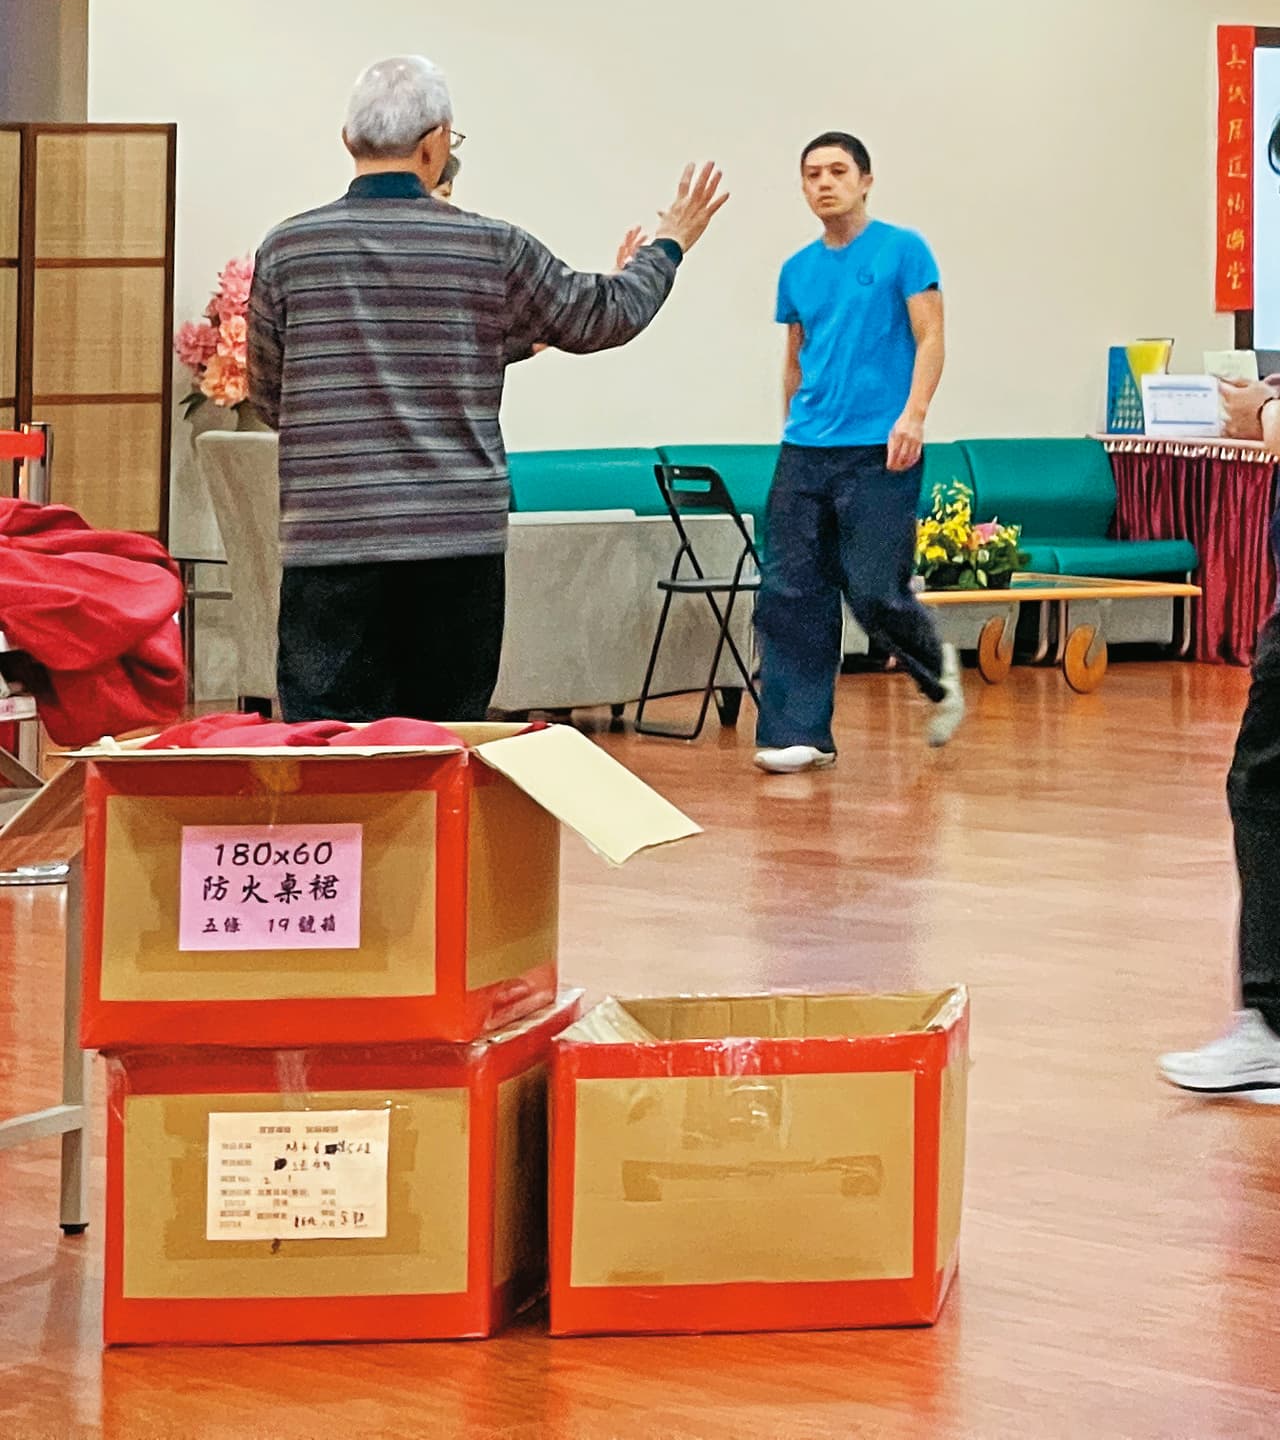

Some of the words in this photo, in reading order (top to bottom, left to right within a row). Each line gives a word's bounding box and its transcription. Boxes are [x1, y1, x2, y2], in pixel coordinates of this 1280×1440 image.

[214, 841, 333, 866] 180x60
[203, 873, 339, 904] 防火桌裙
